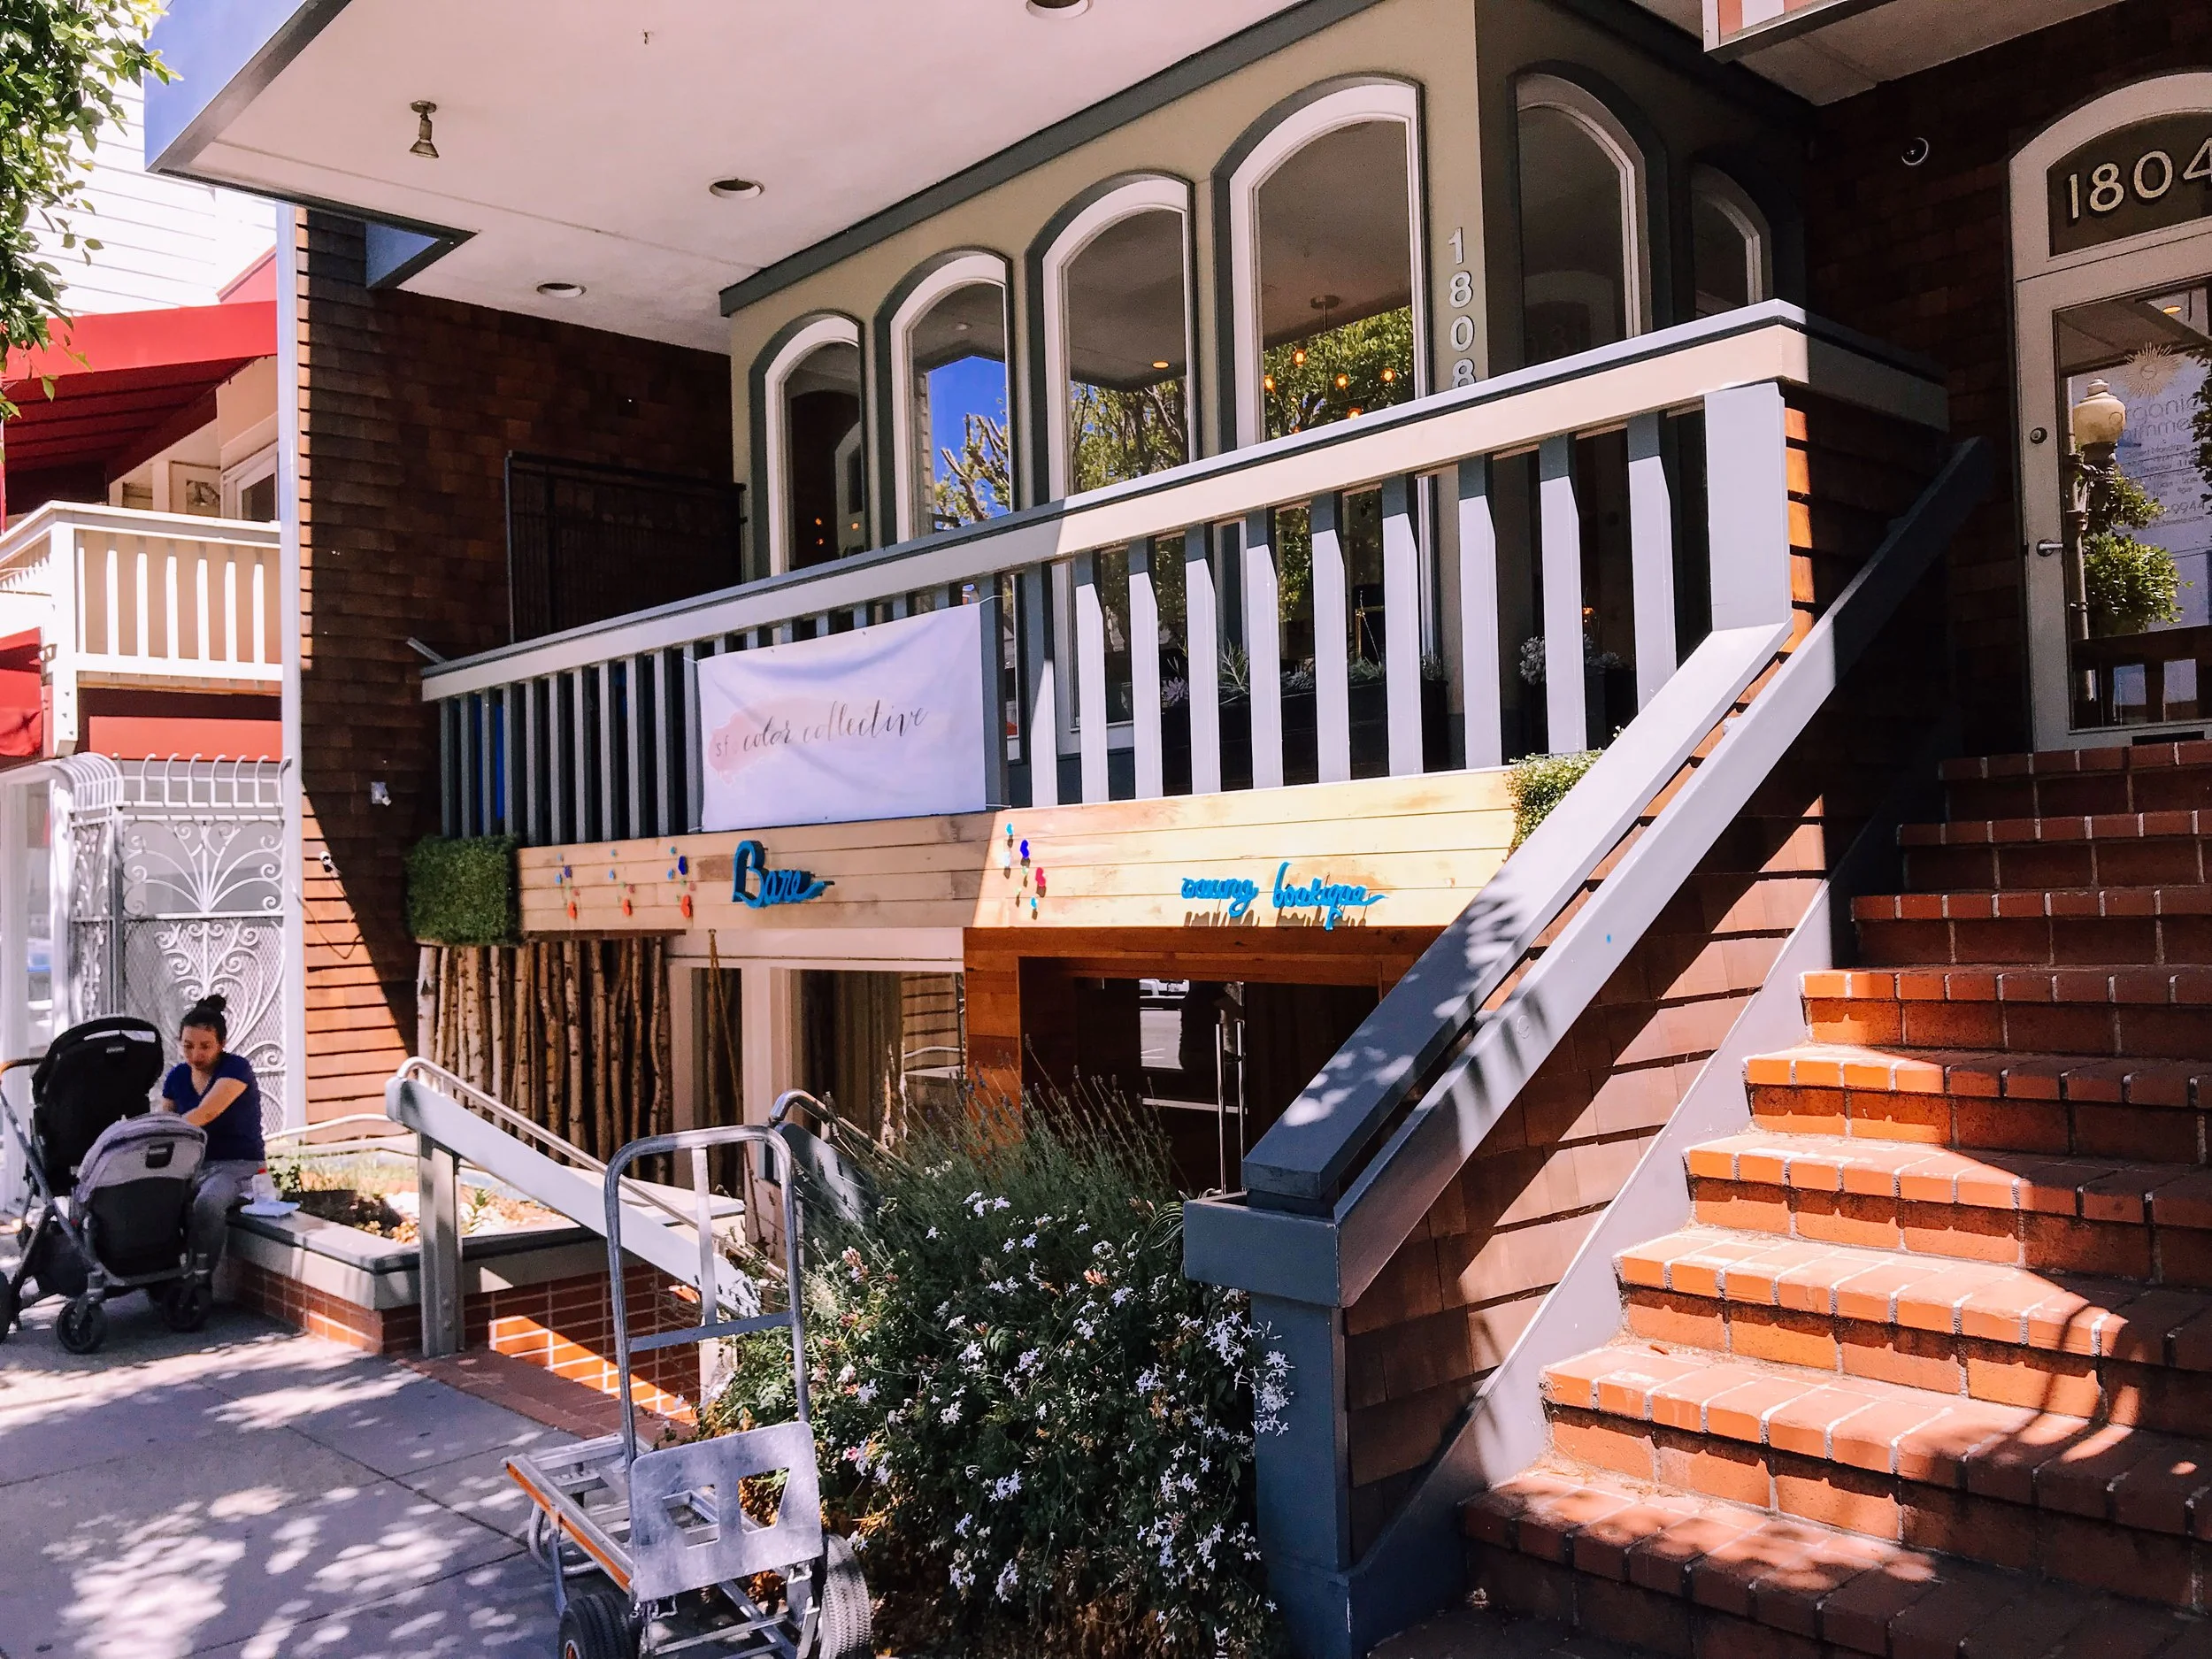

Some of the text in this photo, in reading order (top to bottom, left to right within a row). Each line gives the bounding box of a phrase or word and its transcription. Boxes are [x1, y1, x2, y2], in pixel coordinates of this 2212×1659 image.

[2069, 137, 2212, 219] 1804
[1448, 227, 1477, 389] 1808
[742, 716, 793, 751] color
[803, 699, 929, 744] collective
[732, 840, 833, 910] Bare
[1272, 861, 1388, 932] boutique
